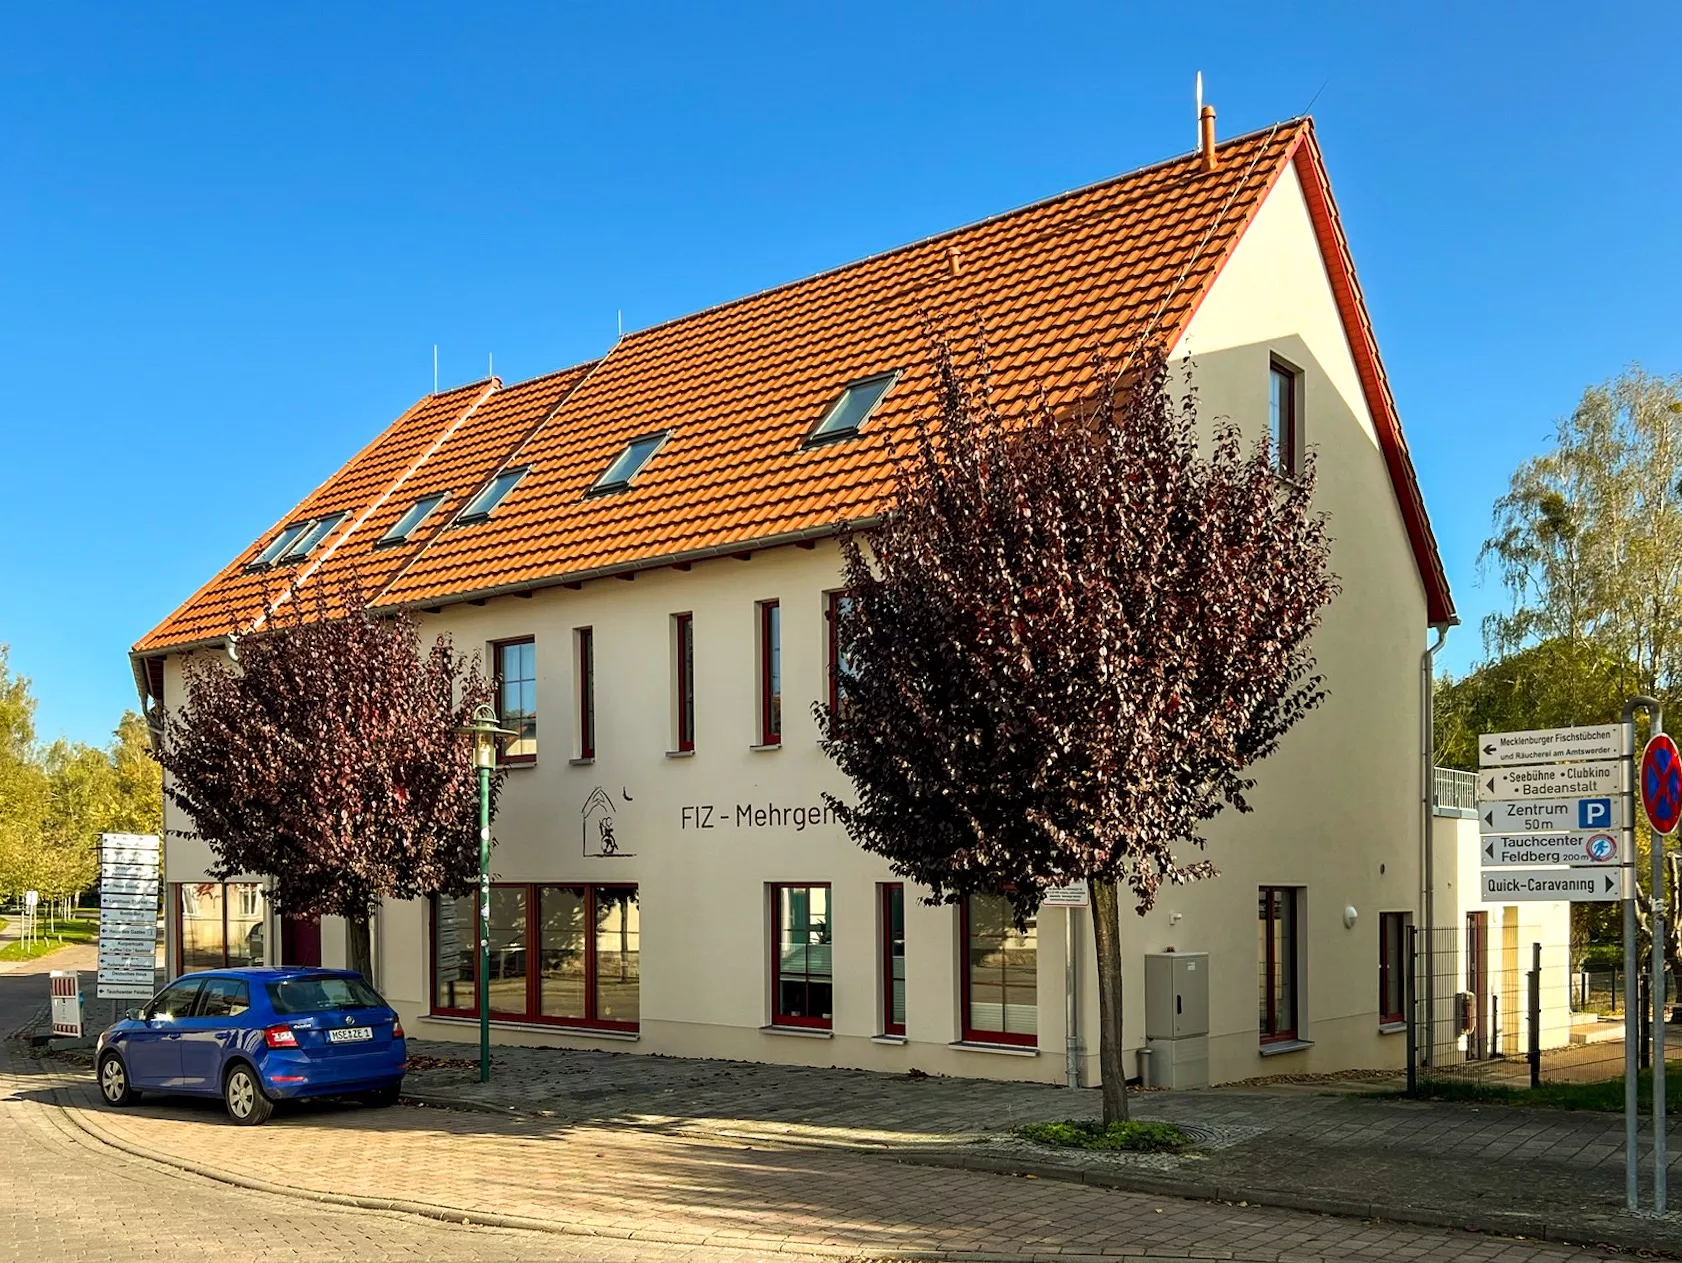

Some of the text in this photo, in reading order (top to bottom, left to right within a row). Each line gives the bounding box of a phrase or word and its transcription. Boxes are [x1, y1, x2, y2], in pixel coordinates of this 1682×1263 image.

[1500, 731, 1611, 747] Mecklenburger Fischstübchen
[1500, 752, 1514, 760] und
[1516, 750, 1551, 759] Räucherei
[1509, 767, 1610, 783] Seebühne Clubkino
[1523, 780, 1597, 795] Badeanstalt
[681, 805, 714, 830] FIZ
[736, 802, 851, 831] Mehrgen
[1507, 803, 1568, 817] Zentrum
[1587, 803, 1605, 825] P
[1501, 836, 1583, 848] Tauchcenter
[1501, 850, 1560, 863] Feldberg
[1488, 878, 1594, 893] Quick-Caravaning
